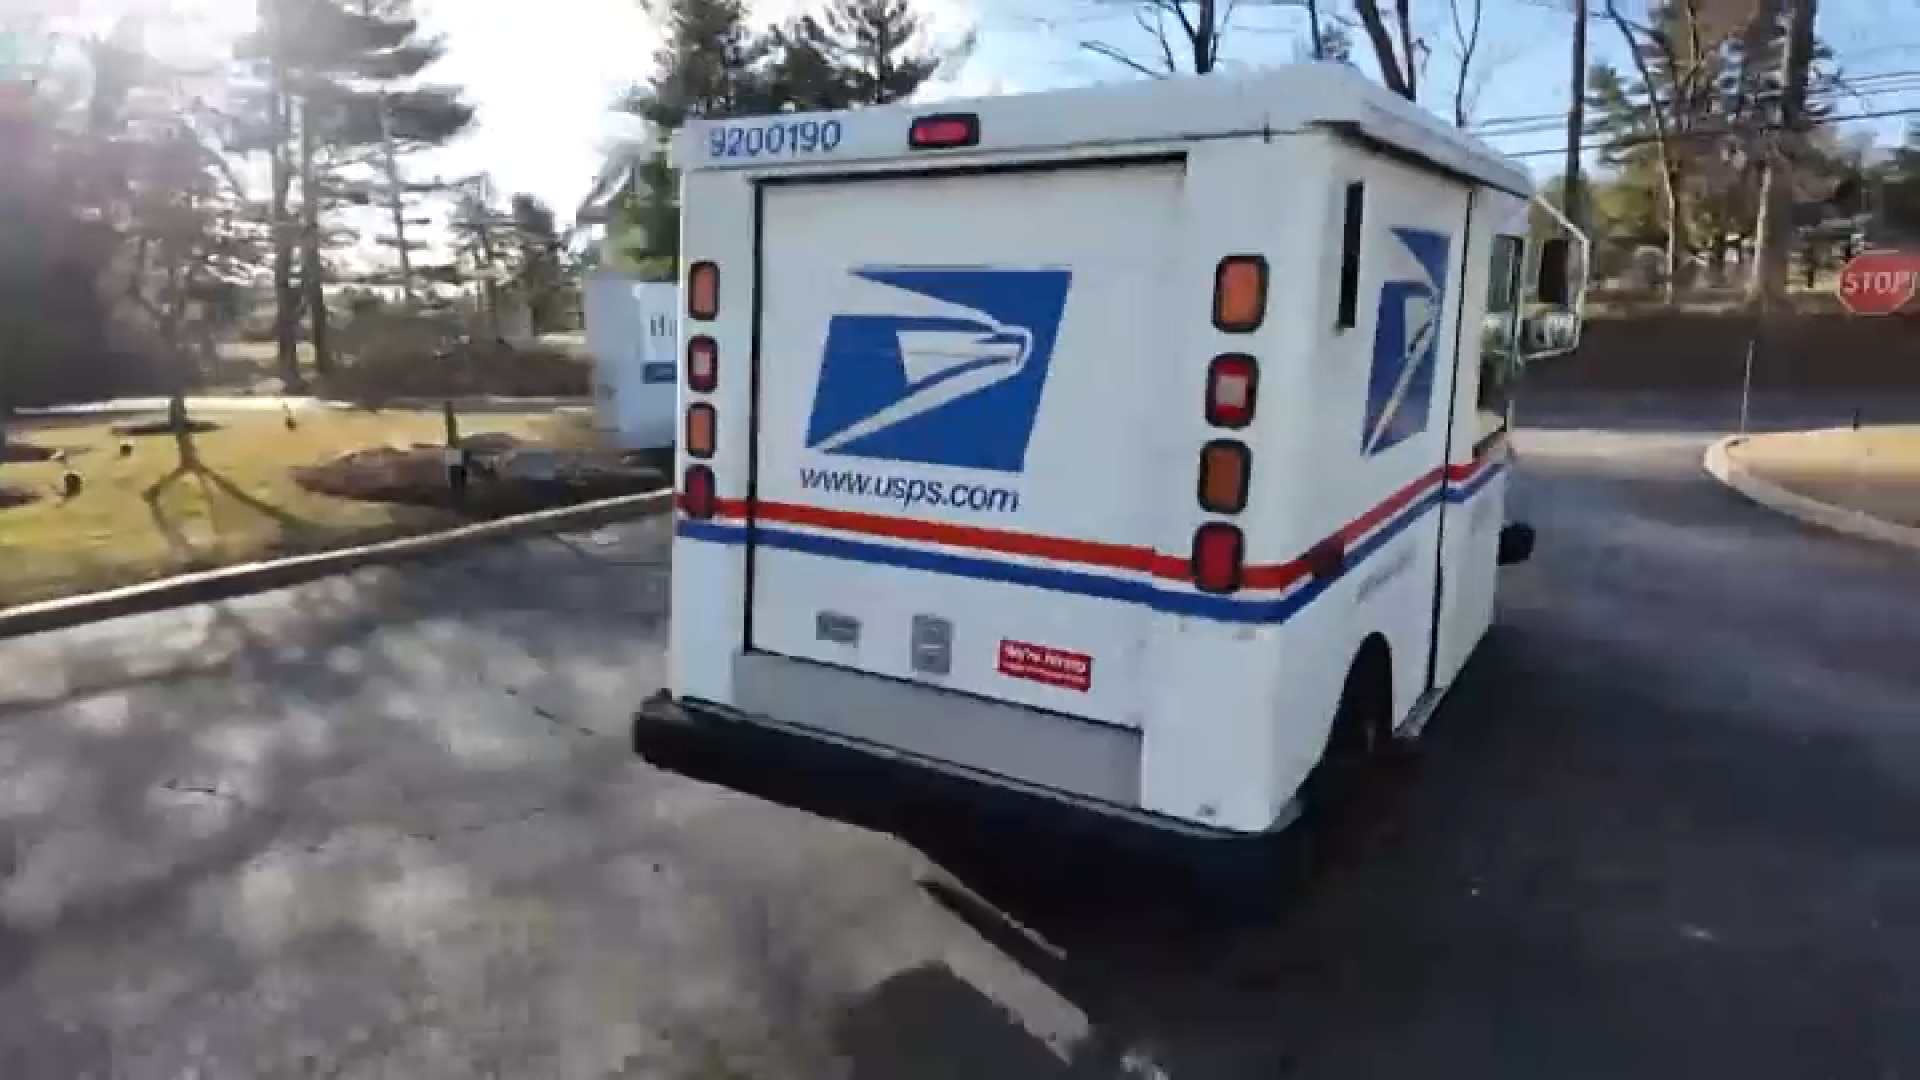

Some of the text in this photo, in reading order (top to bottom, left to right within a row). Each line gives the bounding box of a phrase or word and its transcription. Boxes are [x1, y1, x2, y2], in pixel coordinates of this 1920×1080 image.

[709, 120, 842, 157] 9200190
[1843, 270, 1910, 295] STOP
[799, 467, 1020, 513] www.usps.com
